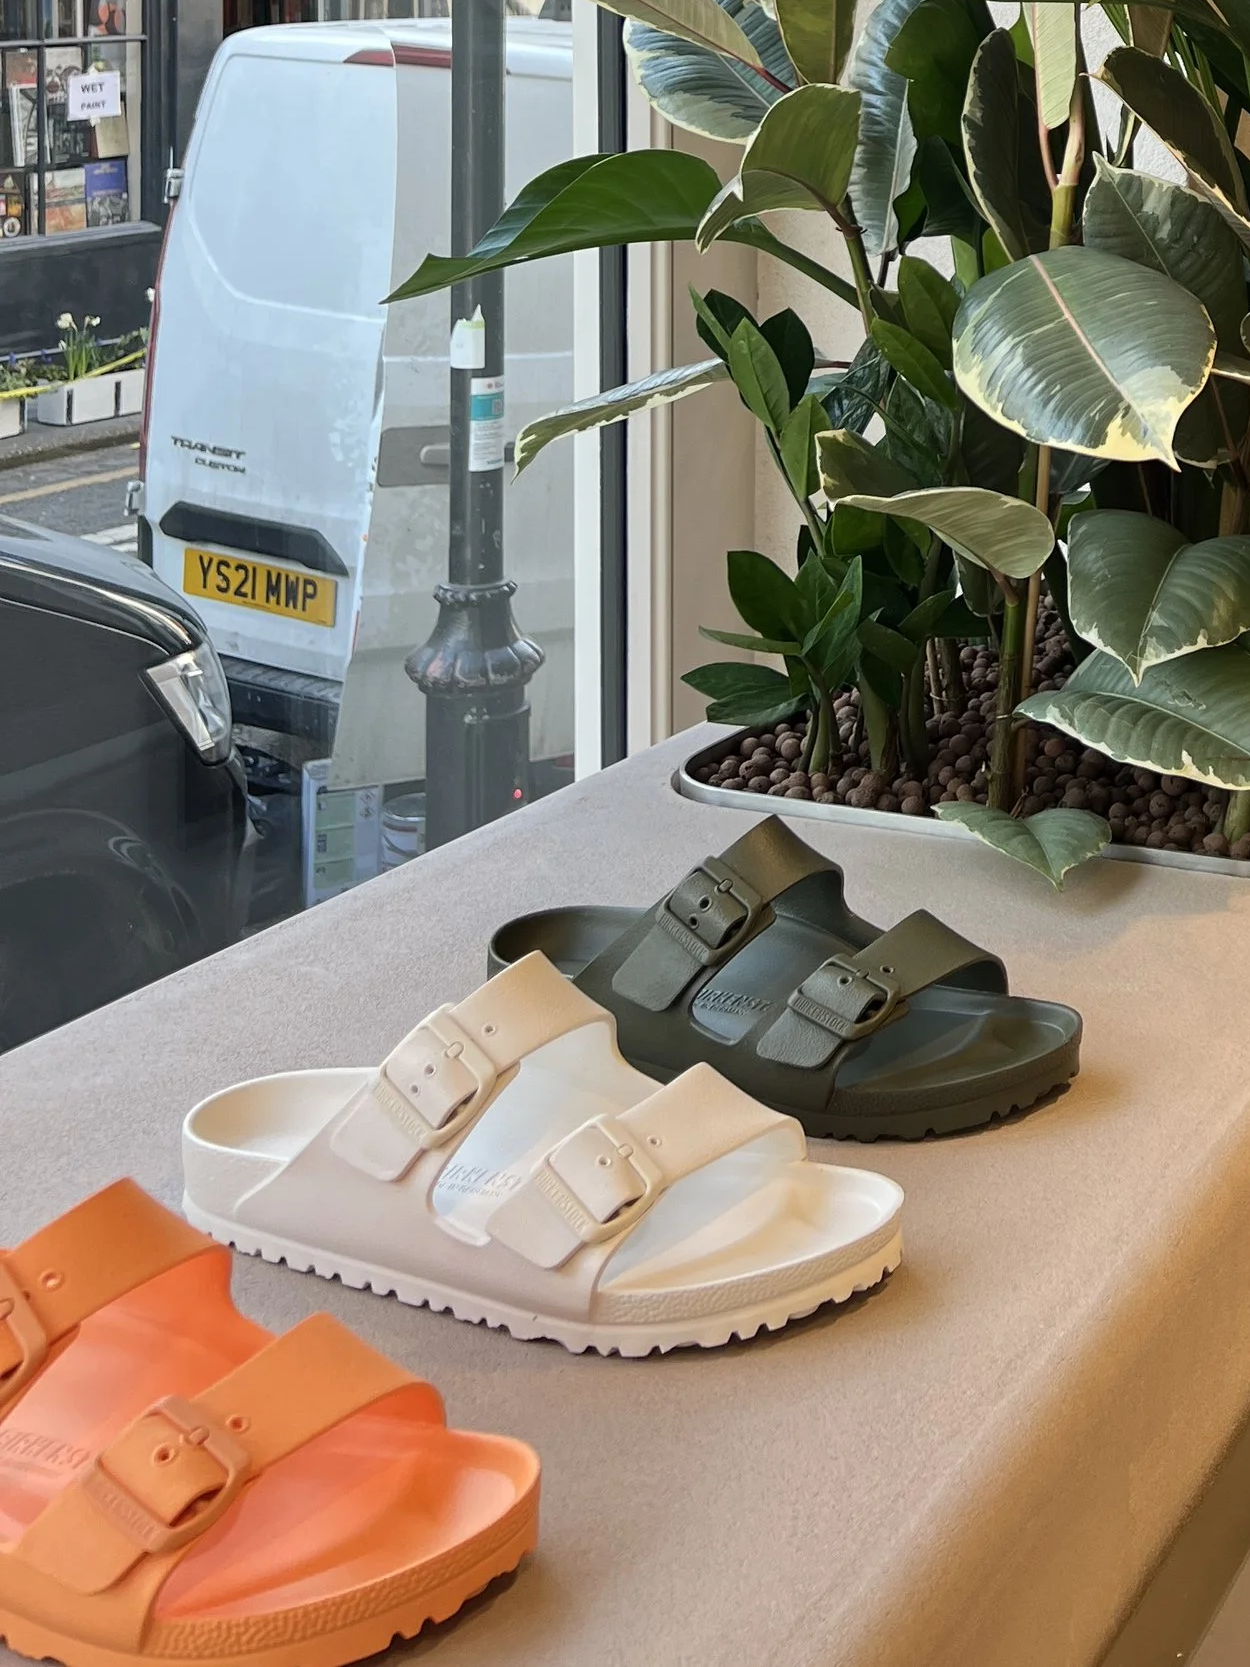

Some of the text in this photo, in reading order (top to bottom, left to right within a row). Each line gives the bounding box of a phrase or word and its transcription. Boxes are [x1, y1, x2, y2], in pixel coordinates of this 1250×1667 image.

[171, 435, 246, 460] TRANSIT
[198, 554, 318, 613] YS21 MWP
